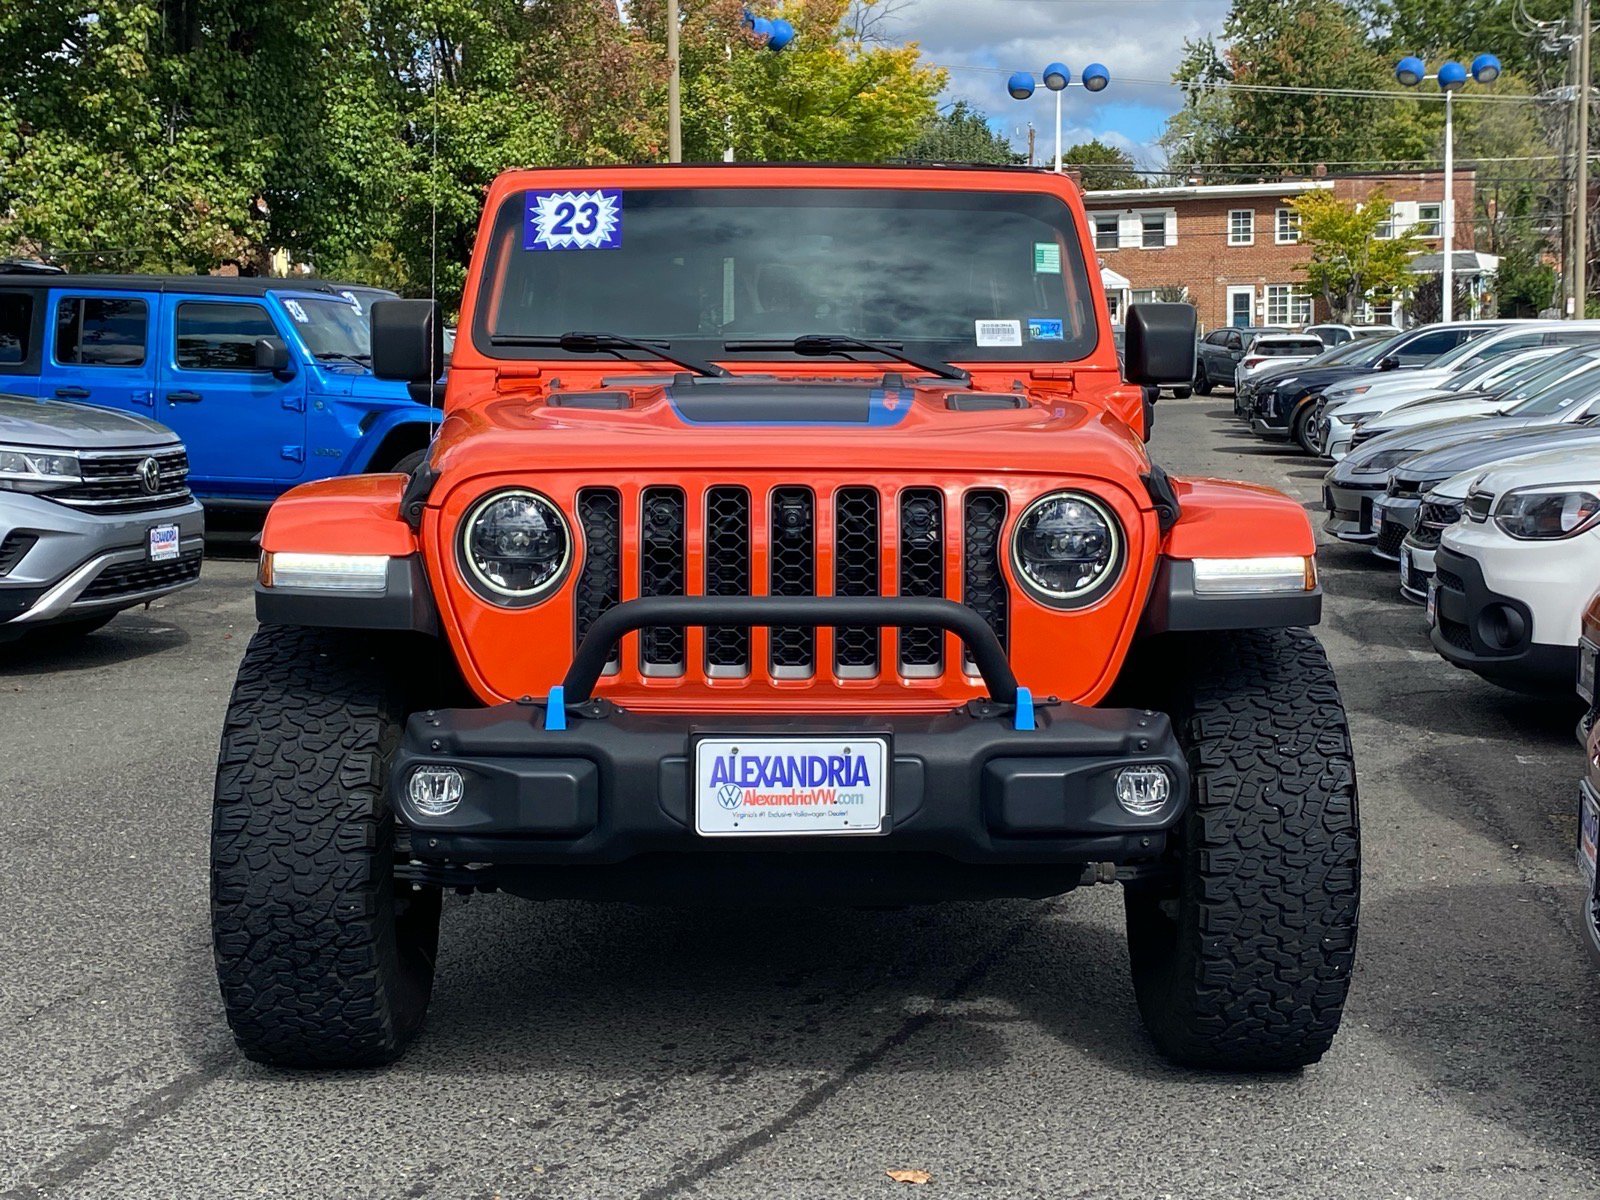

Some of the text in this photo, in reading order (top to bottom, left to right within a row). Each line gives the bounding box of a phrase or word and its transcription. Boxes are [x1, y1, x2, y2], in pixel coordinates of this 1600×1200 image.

[550, 201, 599, 236] 23
[709, 755, 870, 788] ALEXANDRIA
[743, 788, 864, 806] AlexandriaVW.com
